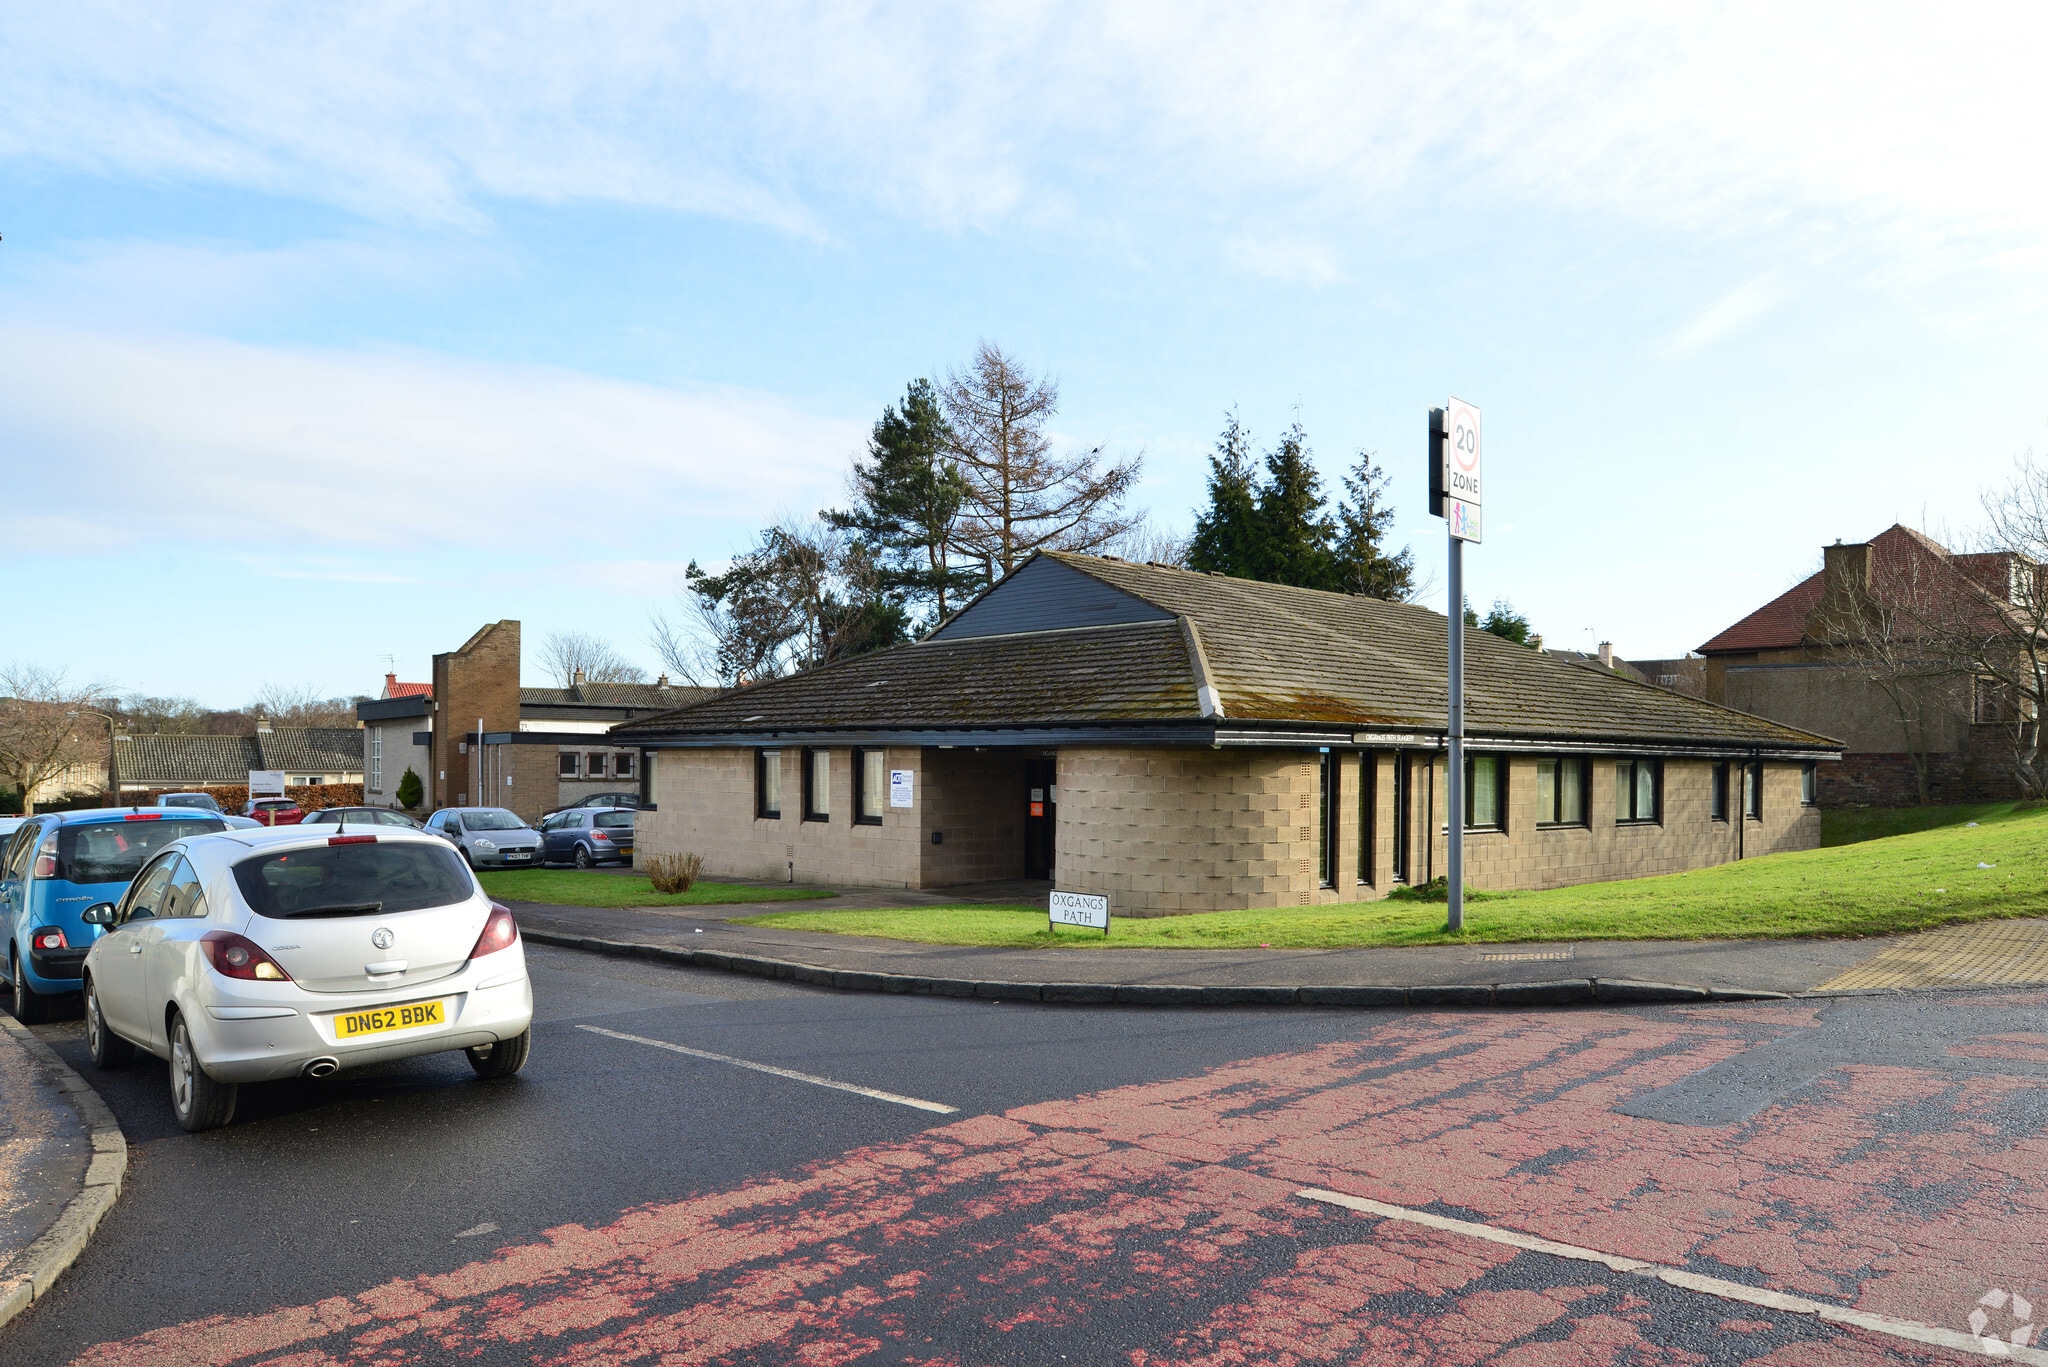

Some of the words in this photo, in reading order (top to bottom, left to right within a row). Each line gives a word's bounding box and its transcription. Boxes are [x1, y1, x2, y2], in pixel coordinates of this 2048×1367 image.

[1456, 424, 1475, 454] 20
[1453, 472, 1479, 494] ZONE
[1052, 894, 1104, 911] OXGANGS
[1064, 909, 1092, 923] PATH
[345, 1010, 396, 1034] DN62
[400, 1004, 438, 1026] BBK
